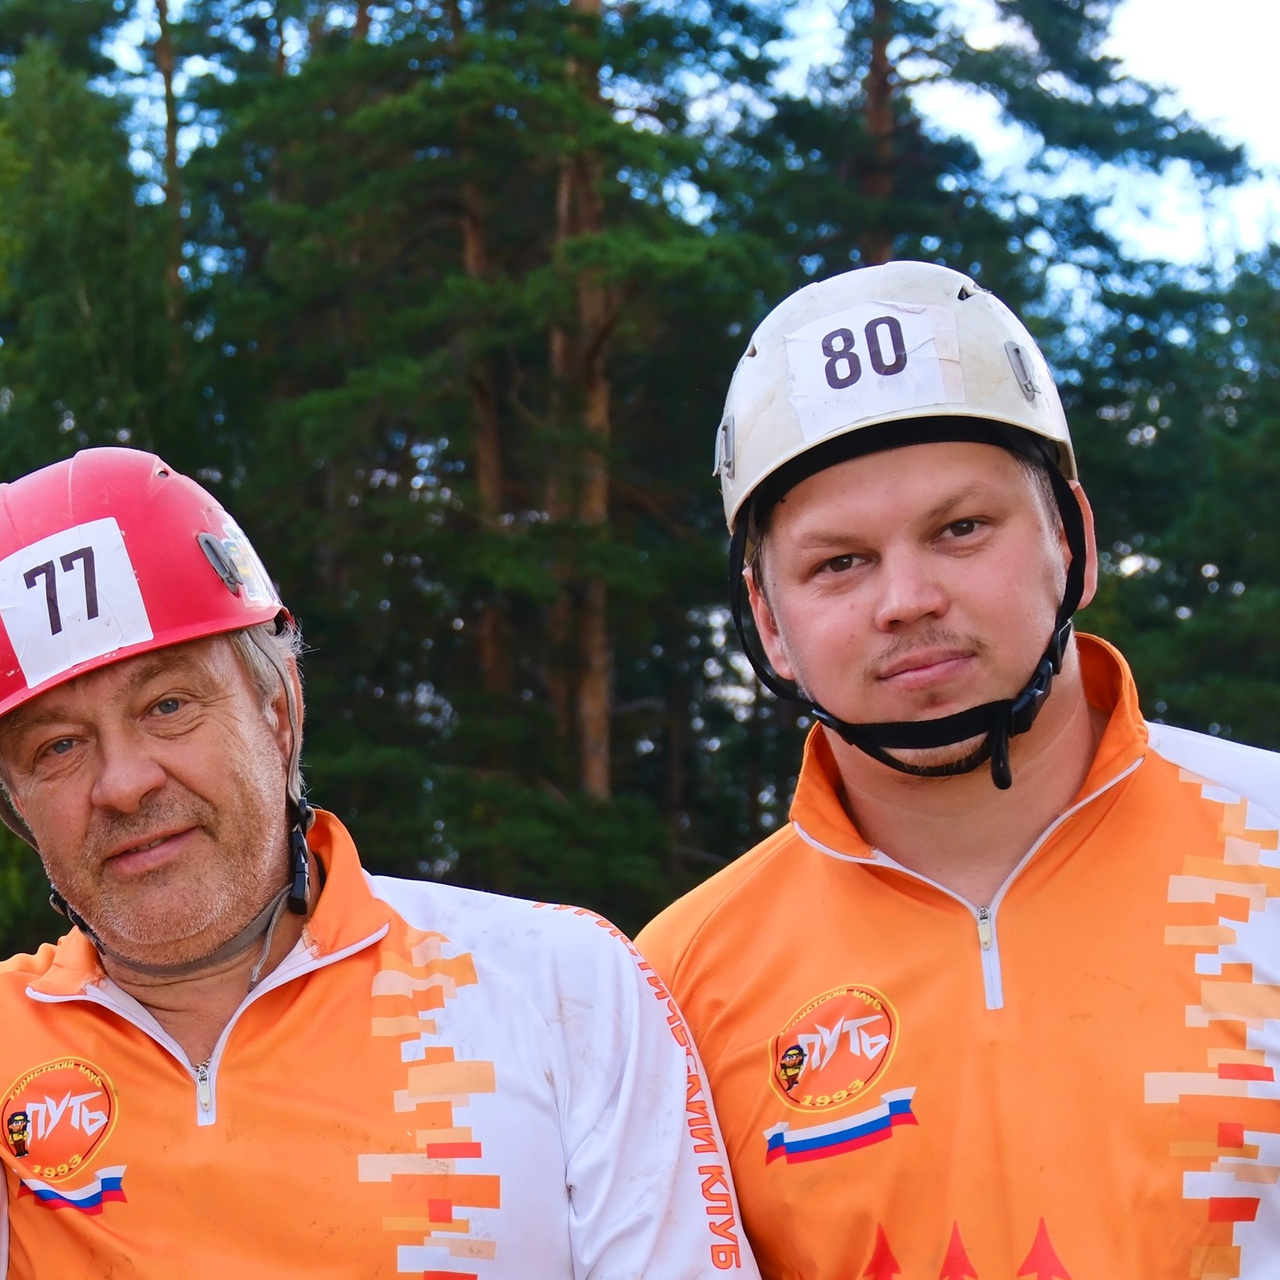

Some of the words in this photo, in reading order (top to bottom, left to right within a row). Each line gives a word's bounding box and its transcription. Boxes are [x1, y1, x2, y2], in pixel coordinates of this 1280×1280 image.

[821, 315, 908, 389] 80
[23, 546, 99, 636] 77
[852, 989, 882, 1012] клуб
[797, 1015, 890, 1079] ПУТЬ
[9, 1060, 75, 1101] туристский
[79, 1063, 103, 1088] клуб
[800, 1078, 865, 1107] 1993
[24, 1090, 108, 1148] ПУТЬ
[32, 1154, 82, 1177] 1993
[698, 1164, 742, 1270] КЛУБ
